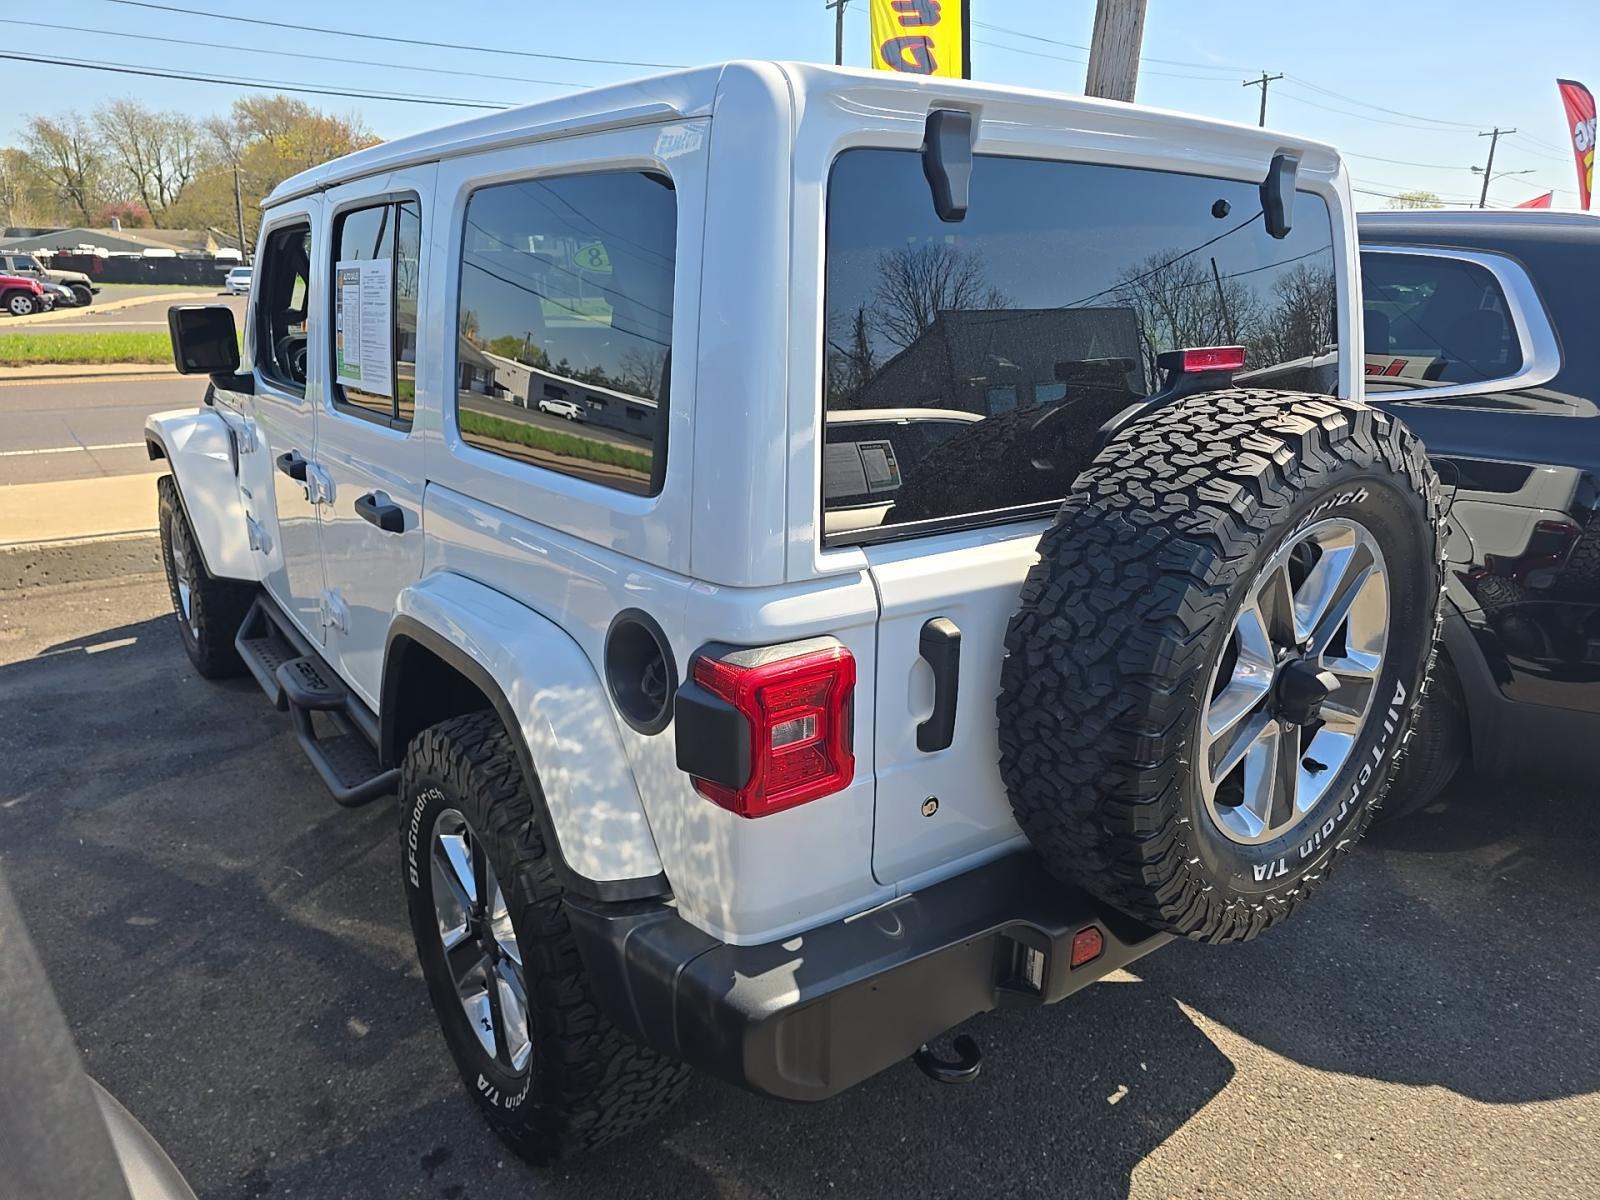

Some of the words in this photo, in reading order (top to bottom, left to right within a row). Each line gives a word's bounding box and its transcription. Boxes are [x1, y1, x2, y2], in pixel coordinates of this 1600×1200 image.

[1298, 679, 1407, 859] All-Terrain
[408, 787, 446, 888] BFGoodrich
[1253, 858, 1289, 881] T/A
[477, 1073, 500, 1106] T/A
